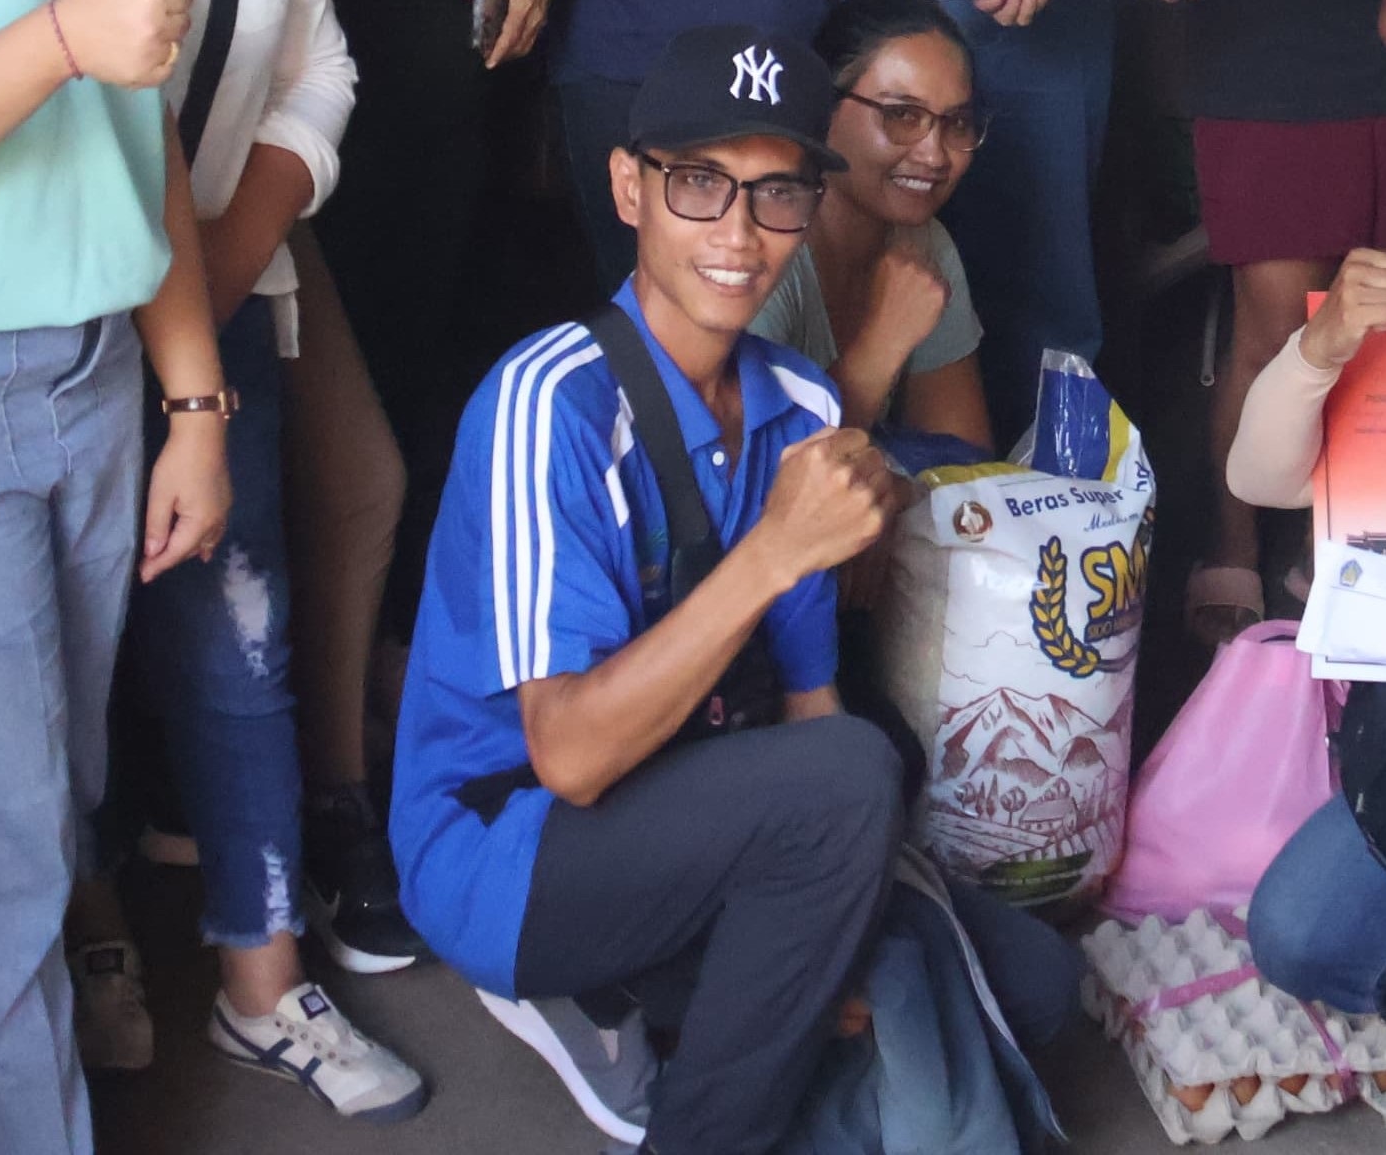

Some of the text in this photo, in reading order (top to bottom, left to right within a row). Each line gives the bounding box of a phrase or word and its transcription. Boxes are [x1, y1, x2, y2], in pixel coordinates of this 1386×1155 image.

[729, 45, 783, 106] NY
[1005, 486, 1124, 517] Beras Super
